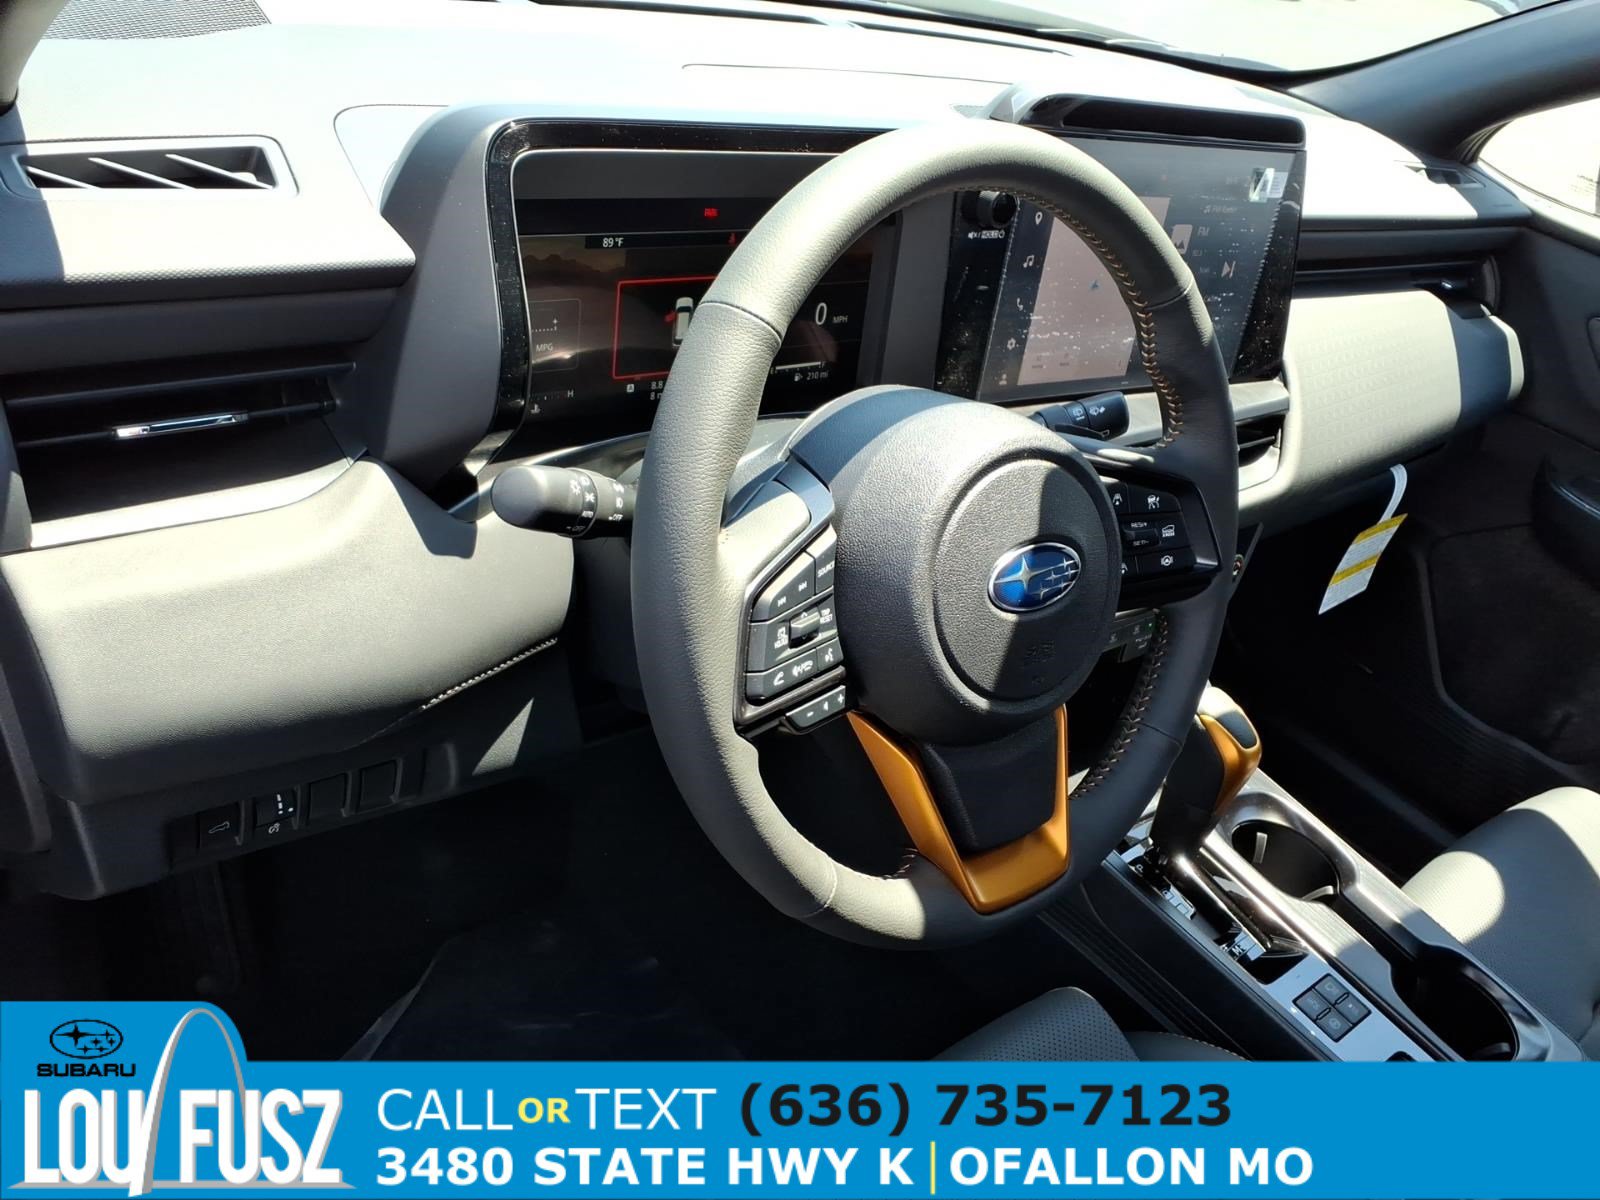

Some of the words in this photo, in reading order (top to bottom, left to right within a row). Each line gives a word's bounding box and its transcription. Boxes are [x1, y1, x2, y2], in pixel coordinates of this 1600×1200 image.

[815, 302, 827, 325] 0
[832, 315, 848, 324] MPH
[535, 343, 554, 352] MPG
